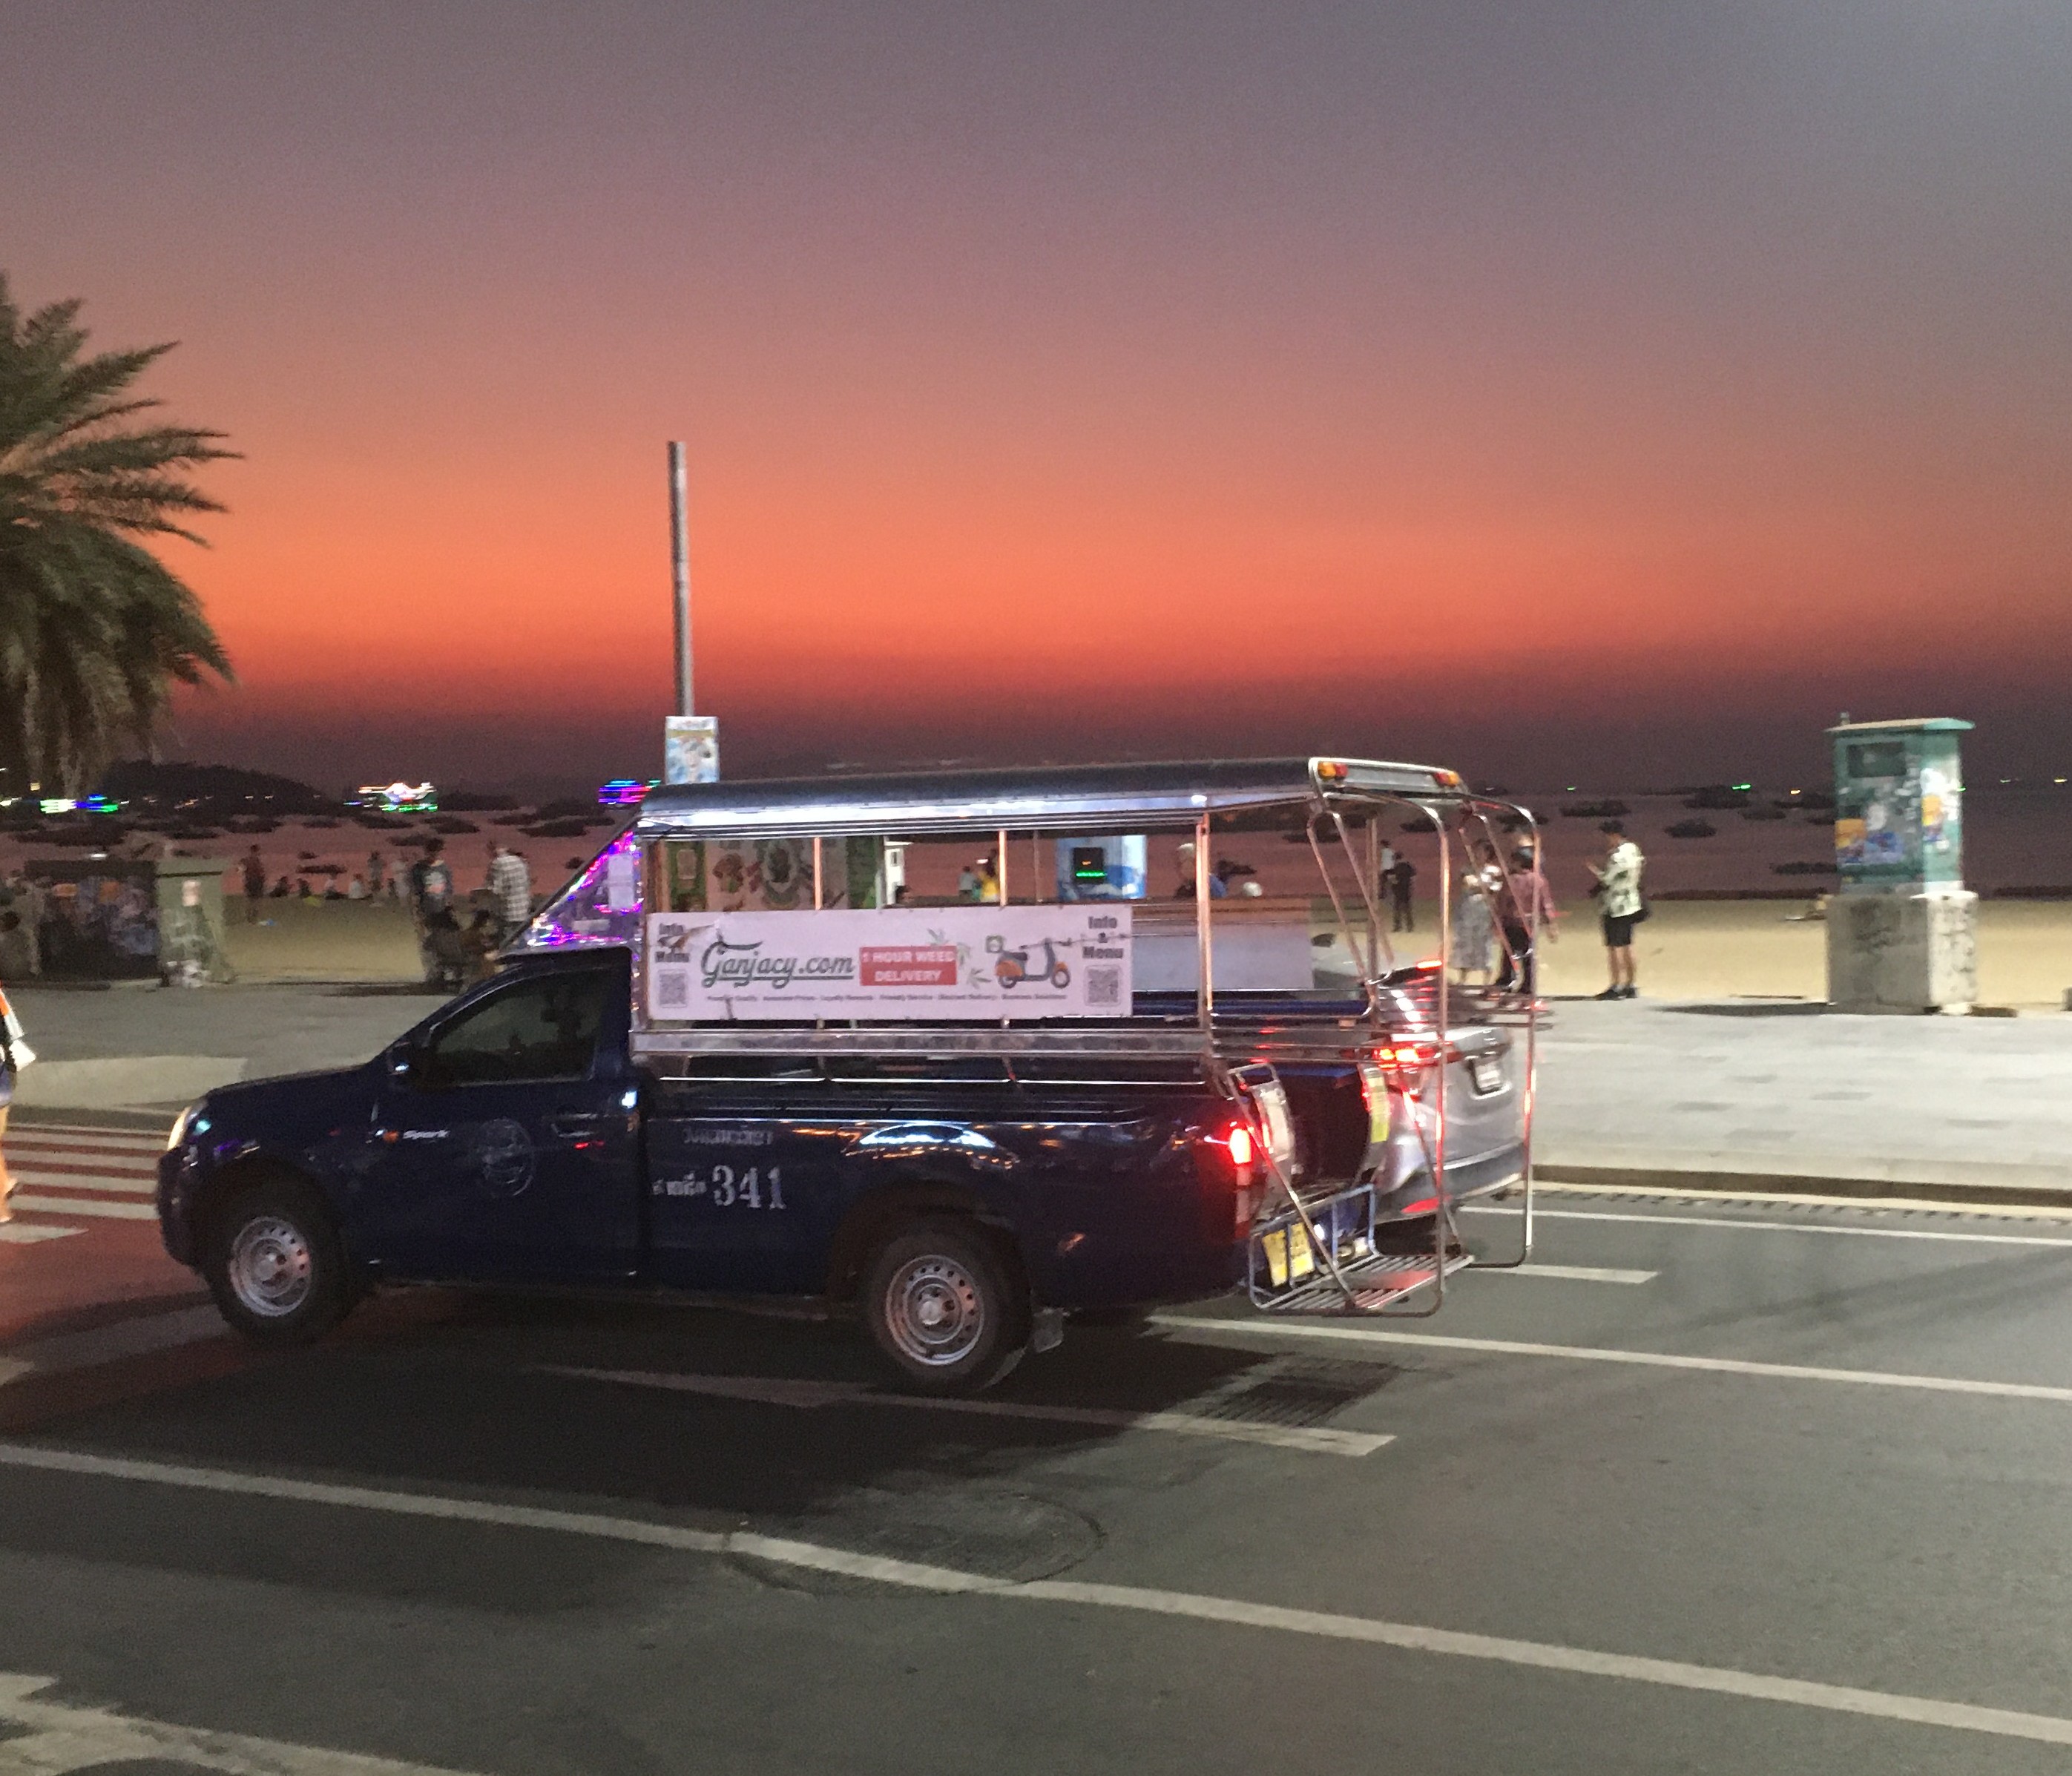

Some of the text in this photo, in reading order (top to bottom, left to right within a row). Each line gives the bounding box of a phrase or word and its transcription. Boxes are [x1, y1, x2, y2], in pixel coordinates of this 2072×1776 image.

[1088, 915, 1117, 929] Info
[872, 951, 912, 963] HOUR
[915, 950, 956, 962] WEED
[1082, 946, 1124, 959] Menu
[700, 939, 855, 989] Ganjacy.com
[874, 970, 943, 982] DELIVERY
[712, 1164, 787, 1209] 341
